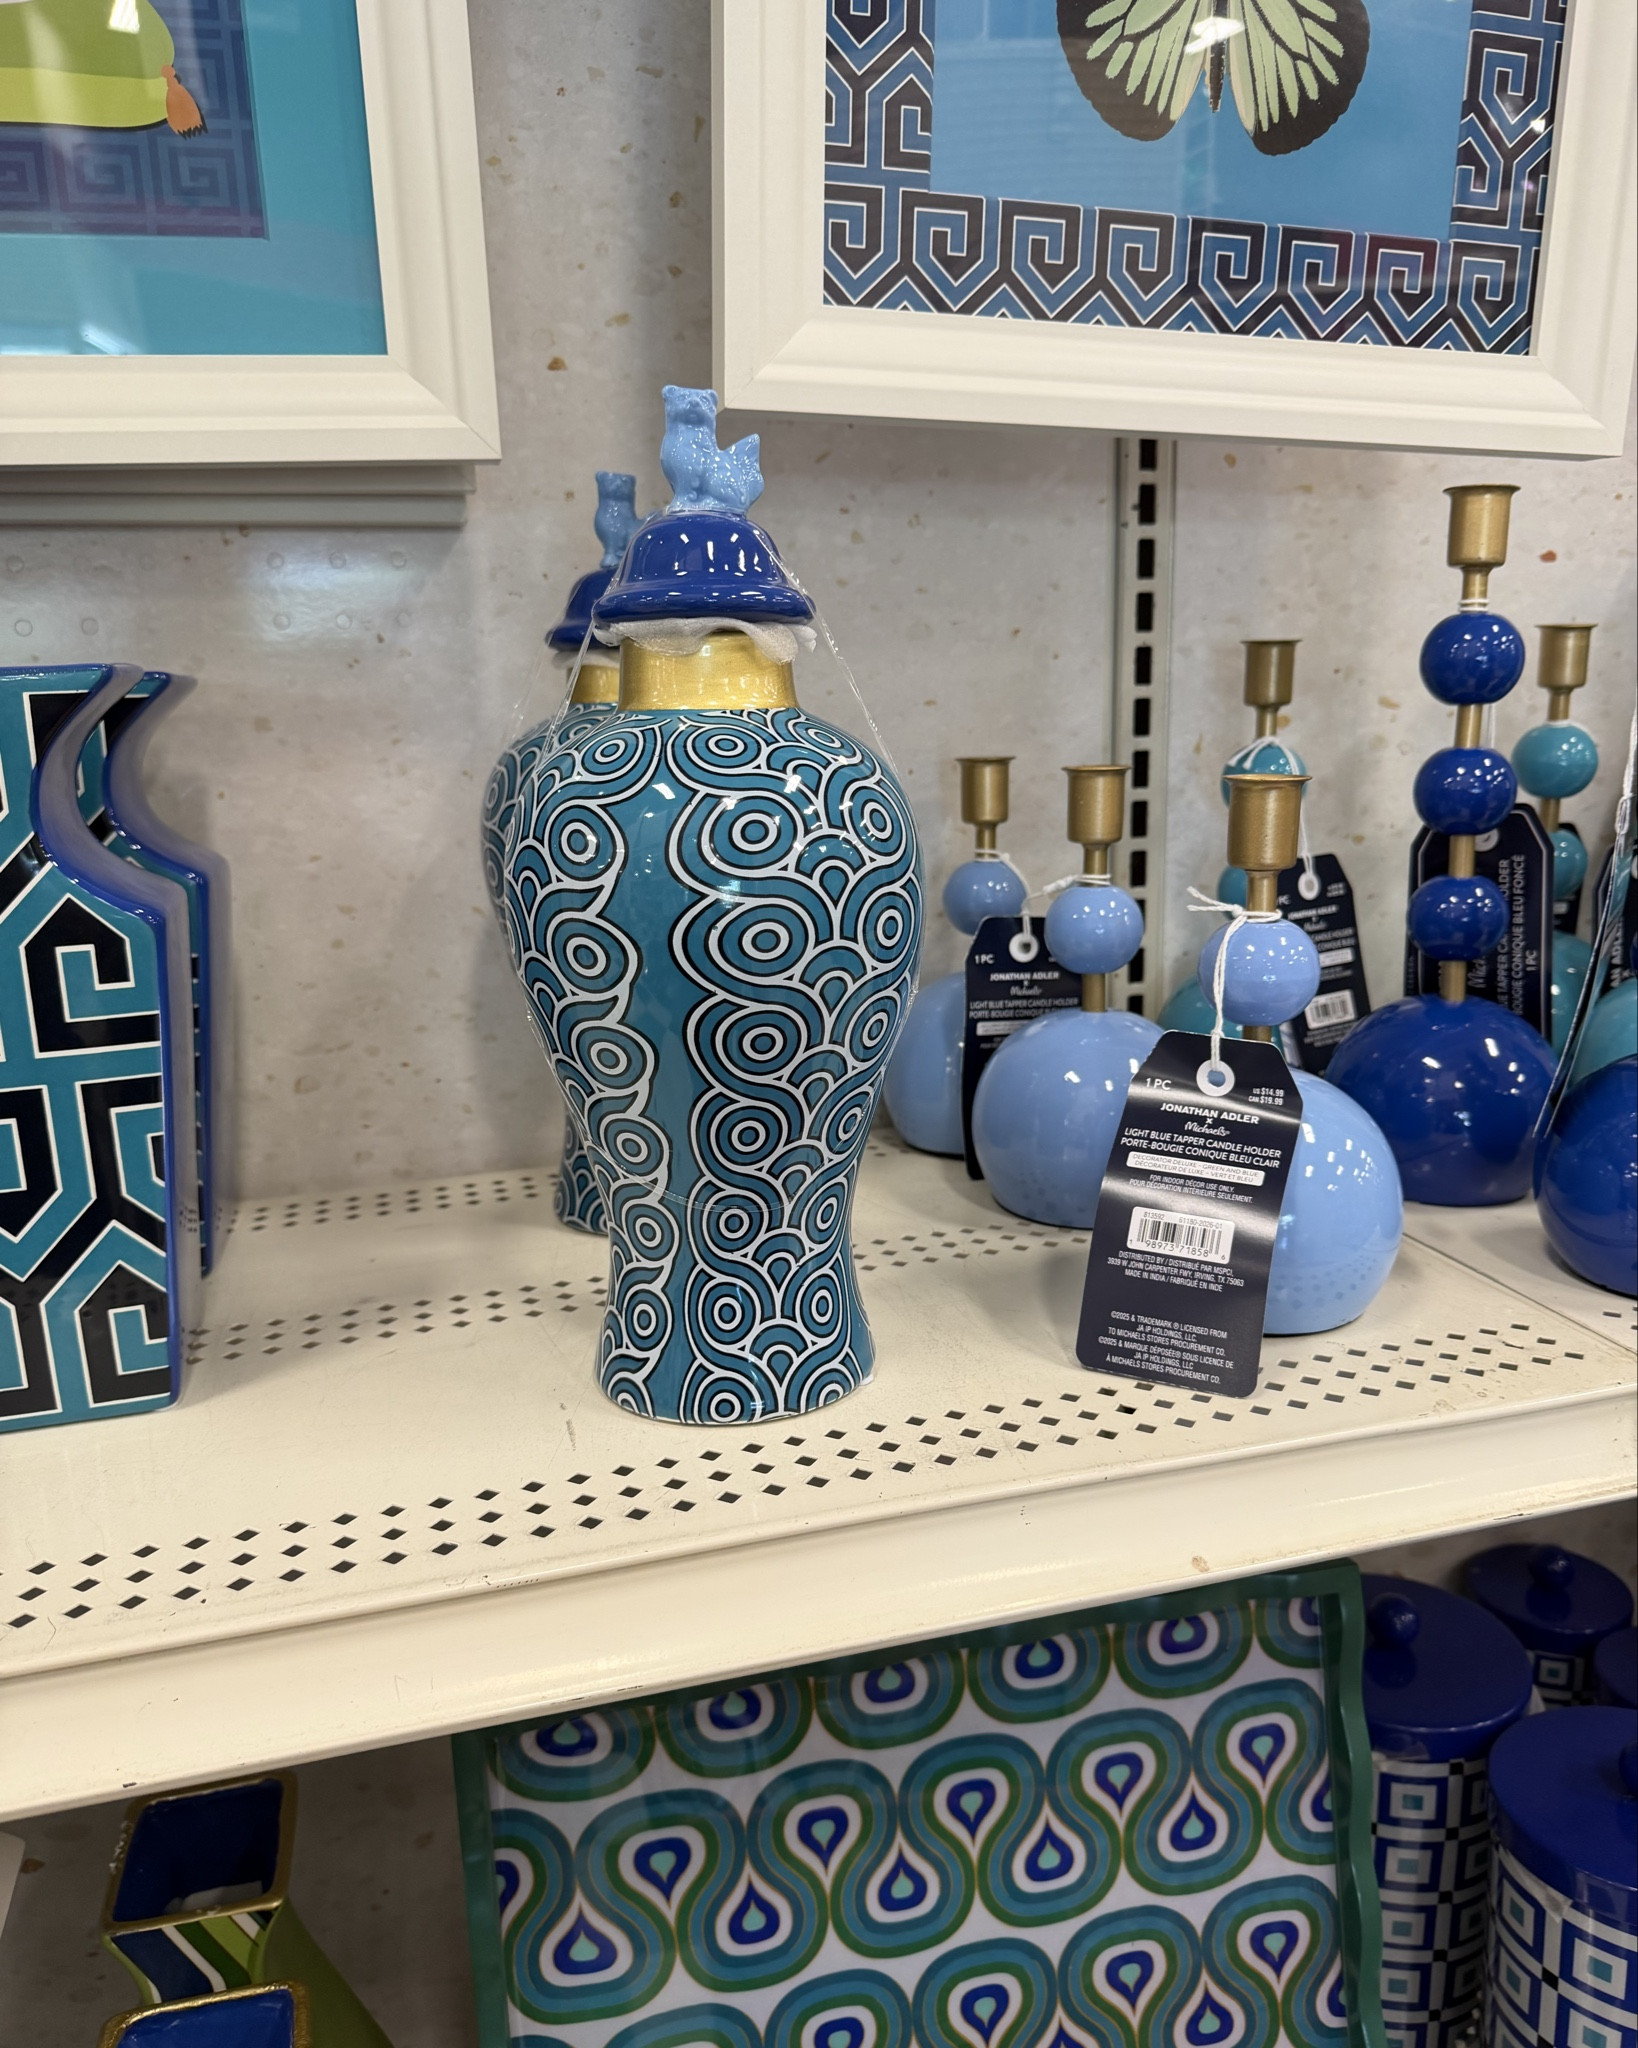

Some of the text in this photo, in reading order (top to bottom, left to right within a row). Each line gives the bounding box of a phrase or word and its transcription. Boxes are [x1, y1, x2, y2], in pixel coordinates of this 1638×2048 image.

[1511, 897, 1525, 924] BLEU
[975, 954, 994, 964] 1 PC
[990, 971, 1059, 982] JONATHAN ADLER
[970, 1000, 987, 1010] LIGHT
[989, 1000, 1003, 1009] BLUE
[1146, 1078, 1172, 1091] 1 PC
[1261, 1087, 1284, 1098] $14.99
[1260, 1096, 1283, 1106] $19.99
[1161, 1103, 1260, 1124] JONATHAN ADLER
[1125, 1127, 1281, 1158] LIGHT BLUE TAPPER CANDLE HOLDER
[1121, 1137, 1280, 1168] PORTE-BOUGIE CONIQUE BLEU CLAIR
[1134, 1154, 1172, 1164] DECORATOR
[1173, 1160, 1196, 1168] DELUXE
[1203, 1164, 1225, 1172] GREEN
[1135, 1160, 1177, 1171] DÉCORATEUR
[1130, 1179, 1145, 1187] POUR
[1146, 1180, 1182, 1192] DÉCORATION
[1183, 1186, 1216, 1197] INTÉRIEURE
[1162, 1176, 1184, 1185] INDOOR
[1145, 1240, 1175, 1252] 98973
[1179, 1246, 1209, 1257] 71858
[1118, 1251, 1155, 1262] DISTRIBUTED
[1169, 1259, 1200, 1270] DISTRIBUÉ
[1125, 1269, 1141, 1277] MADE
[1150, 1273, 1166, 1282] INDIA
[1170, 1276, 1198, 1288] FABRIQUÉ
[1208, 1284, 1223, 1292] INDE
[1128, 1261, 1144, 1269] JOHN
[1144, 1264, 1178, 1275] CARPENTER
[1226, 1278, 1244, 1286] 75063
[1136, 1316, 1172, 1328] TRADEMARK
[1180, 1324, 1209, 1335] LICENSED
[1210, 1329, 1228, 1339] FROM
[1137, 1324, 1144, 1332] JA
[1108, 1327, 1226, 1356] TO MICHAELS STORES PROCUREMENT CO.
[1124, 1341, 1149, 1352] MARQUE
[1182, 1352, 1199, 1362] SOUS
[1199, 1356, 1224, 1367] LICENCE
[1225, 1361, 1234, 1369] DE
[1111, 1356, 1141, 1367] MICHAELS
[1141, 1362, 1164, 1372] STORES
[1165, 1367, 1210, 1381] PROCUREMENT
[1210, 1375, 1221, 1384] CO.
[1182, 1361, 1194, 1369] LLC
